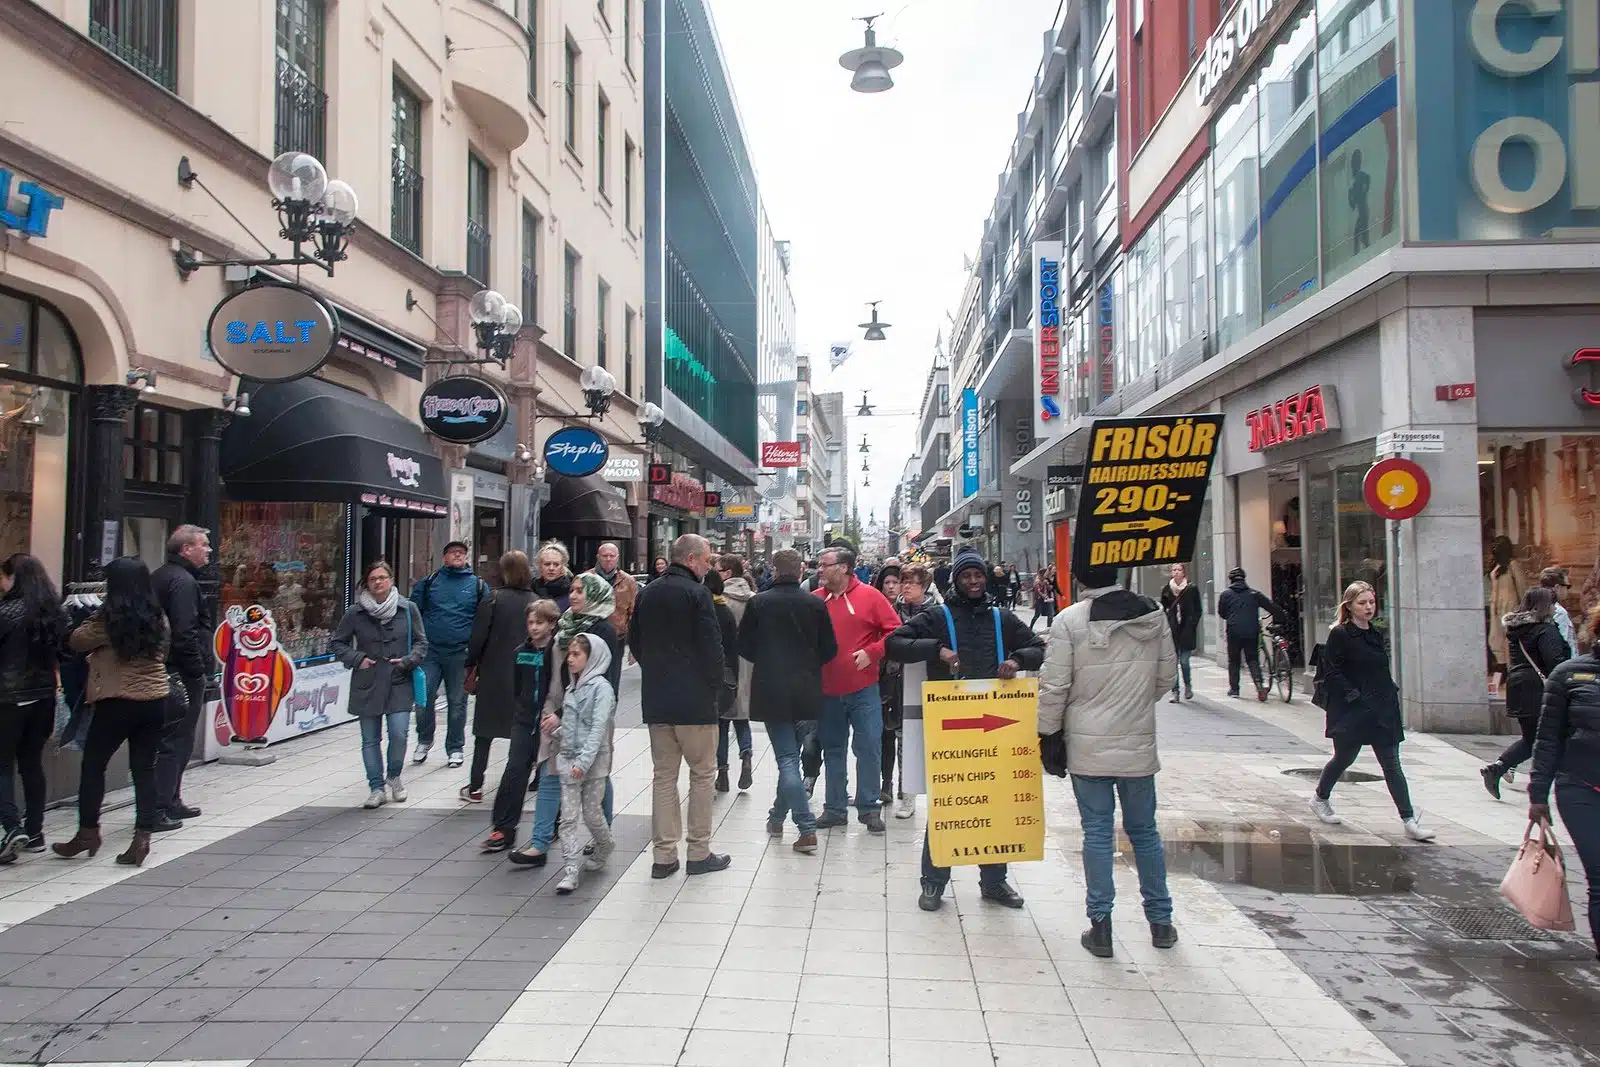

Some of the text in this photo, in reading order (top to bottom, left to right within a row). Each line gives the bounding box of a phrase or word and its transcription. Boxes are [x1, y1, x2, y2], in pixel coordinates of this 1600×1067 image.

[1195, 36, 1235, 107] clas
[224, 319, 317, 345] SALT
[1040, 256, 1060, 395] INTERSPORT
[964, 408, 978, 477] clas ohlson
[1091, 418, 1217, 462] FRISÖR
[603, 468, 641, 477] MODA
[606, 459, 639, 468] VERO
[1088, 460, 1208, 484] HAIRDRESSING
[1012, 489, 1032, 533] clas
[1093, 484, 1192, 516] 290:-
[1089, 535, 1181, 566] DROP IN
[927, 690, 1035, 702] Restaurant London
[931, 746, 1036, 760] KYCKLINGFILÉ 108:-
[967, 771, 996, 782] CHIPS
[1012, 769, 1037, 779] 108:-
[933, 793, 1038, 807] FILÉ OSCAR 118:-
[934, 816, 1040, 831] ENTRECÔTE 125:-
[951, 843, 1026, 857] A LA CARTE
